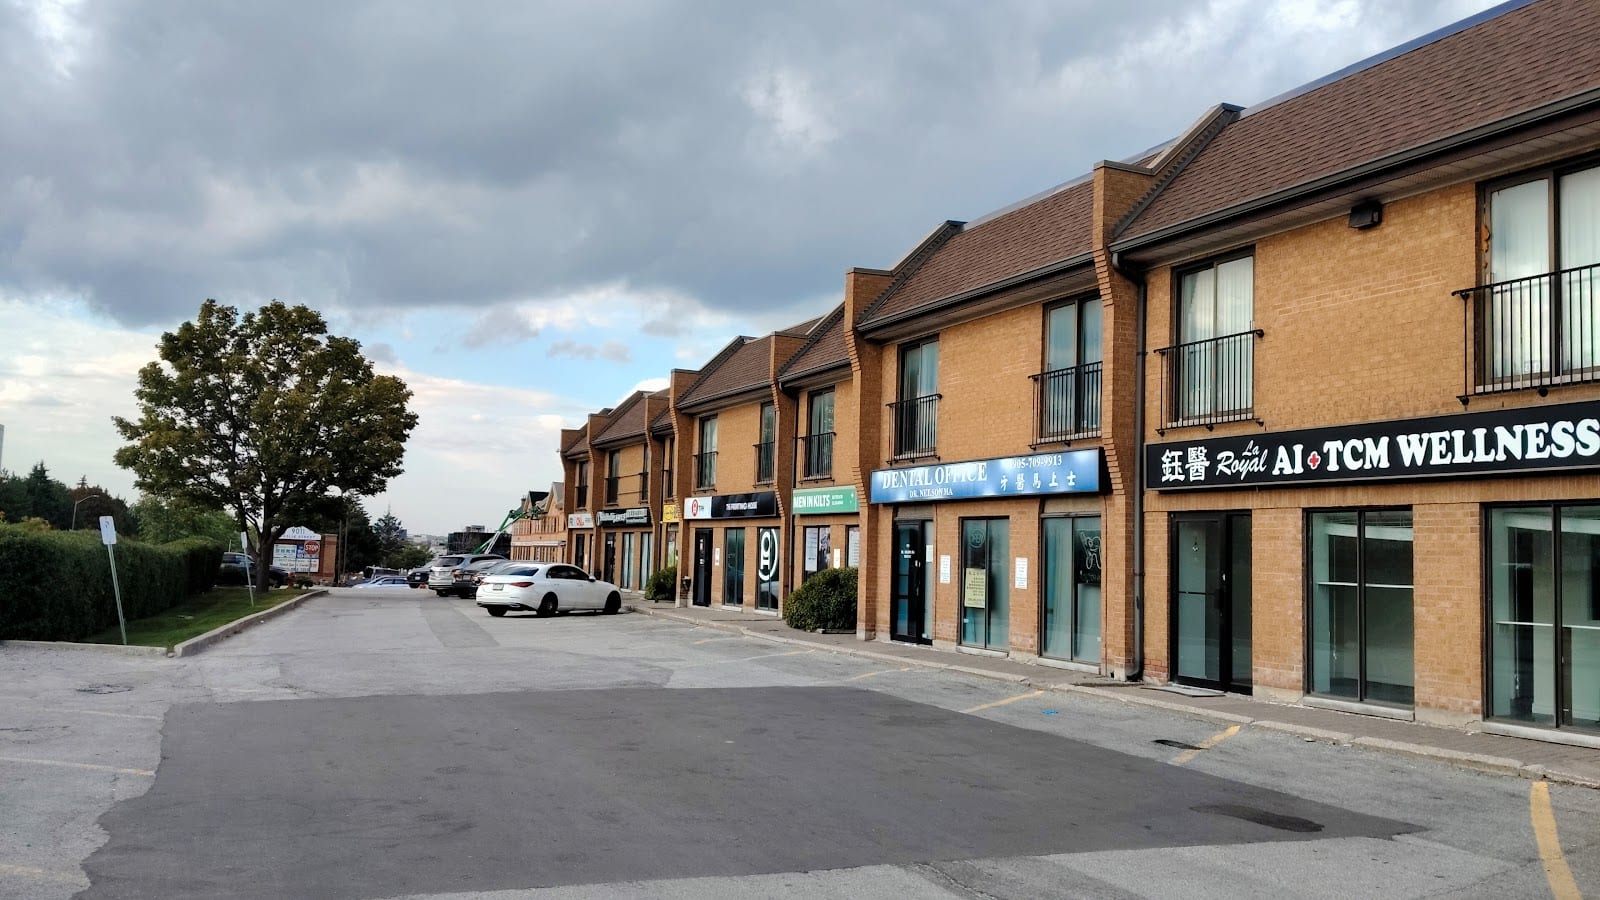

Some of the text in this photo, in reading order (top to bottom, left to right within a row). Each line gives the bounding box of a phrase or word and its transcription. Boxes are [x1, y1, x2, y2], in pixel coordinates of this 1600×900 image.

[1216, 419, 1600, 481] Royal AI TCM WELLNESS
[1243, 440, 1260, 457] La
[882, 462, 988, 489] DENTAL OFFICE
[1161, 446, 1210, 483] 鈺醫
[793, 495, 806, 508] MEN
[807, 495, 813, 507] IN
[813, 494, 830, 507] KILTS
[920, 488, 943, 497] NELSON
